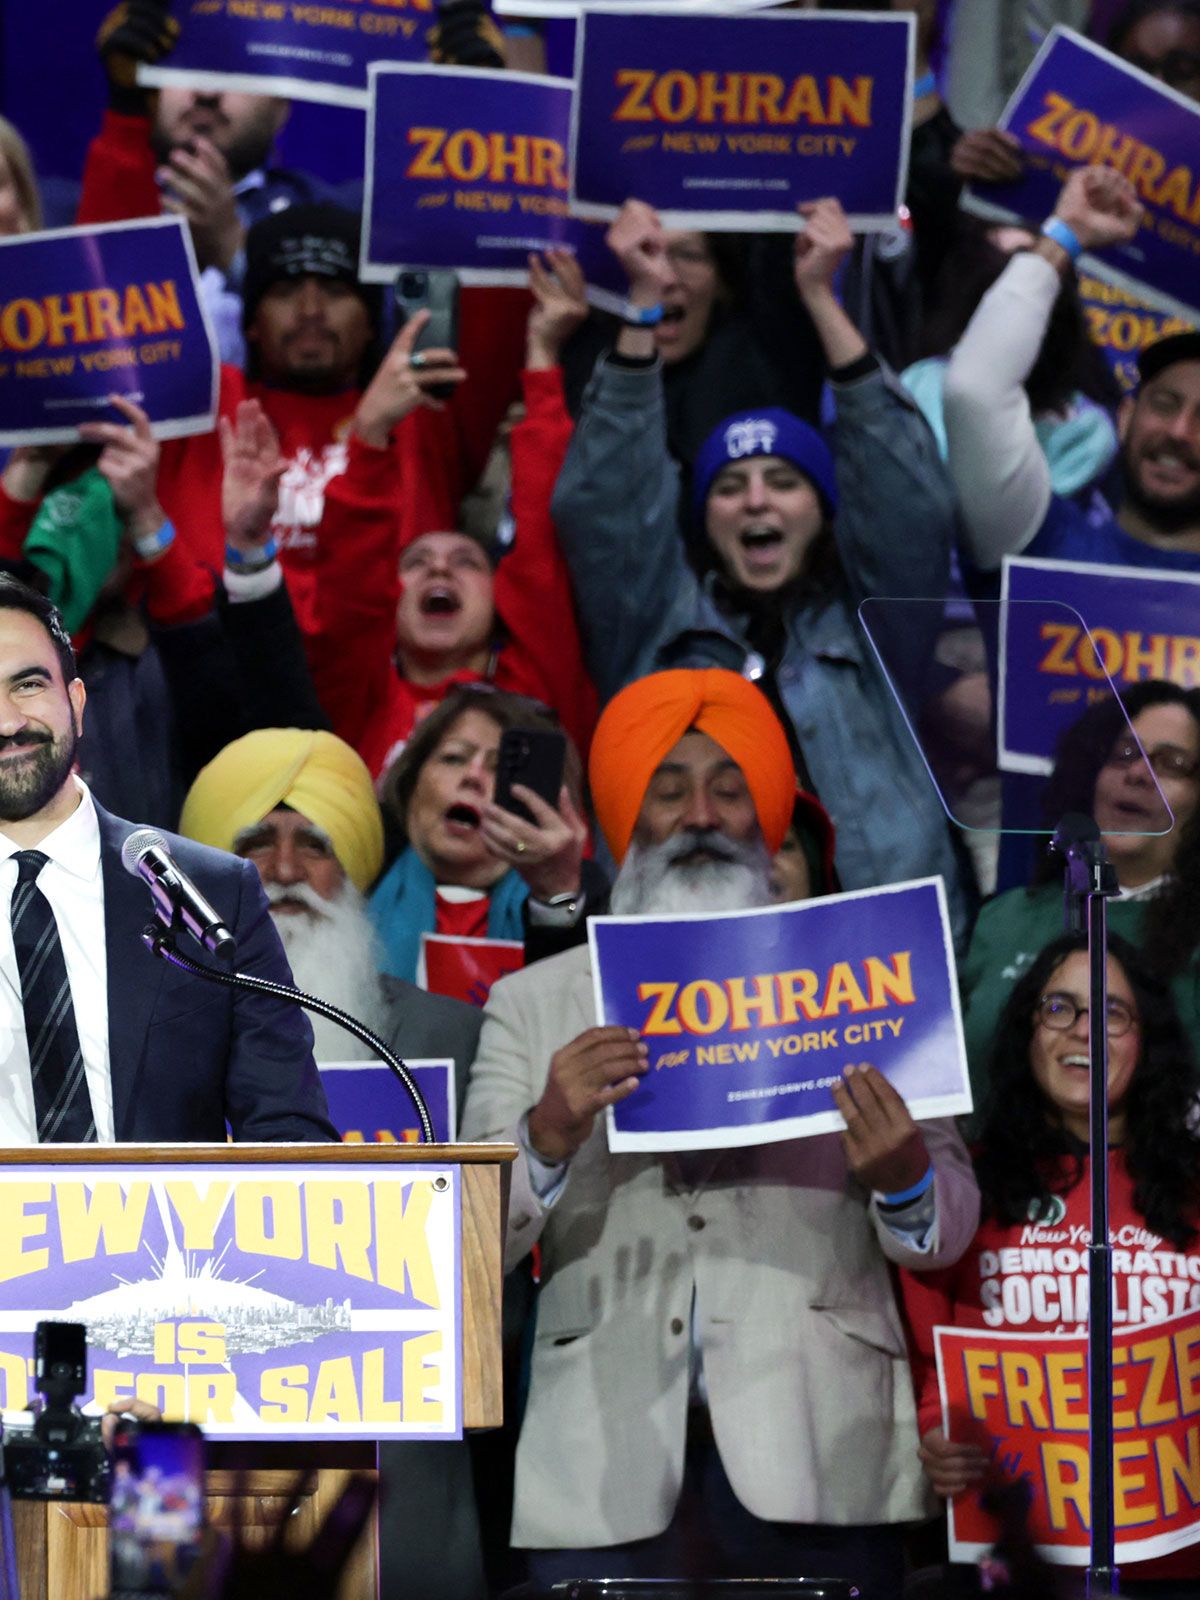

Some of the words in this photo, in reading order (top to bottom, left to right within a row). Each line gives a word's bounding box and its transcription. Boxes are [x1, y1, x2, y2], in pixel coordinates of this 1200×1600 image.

[611, 68, 874, 127] ZOHRAN
[661, 130, 721, 153] NEW
[726, 133, 792, 154] YORK
[796, 134, 857, 157] CITY
[453, 190, 513, 213] NEW
[14, 355, 76, 379] NEW
[79, 346, 138, 372] YORK
[638, 950, 917, 1036] ZOHRAN
[696, 1041, 760, 1066] NEW
[765, 1028, 838, 1058] YORK
[844, 1017, 905, 1045] CITY
[164, 1181, 441, 1310] YORK
[1020, 1225, 1068, 1246] New
[1117, 1225, 1164, 1251] City
[154, 1322, 226, 1364] IS
[93, 1368, 237, 1424] FOR
[260, 1330, 442, 1424] SALE
